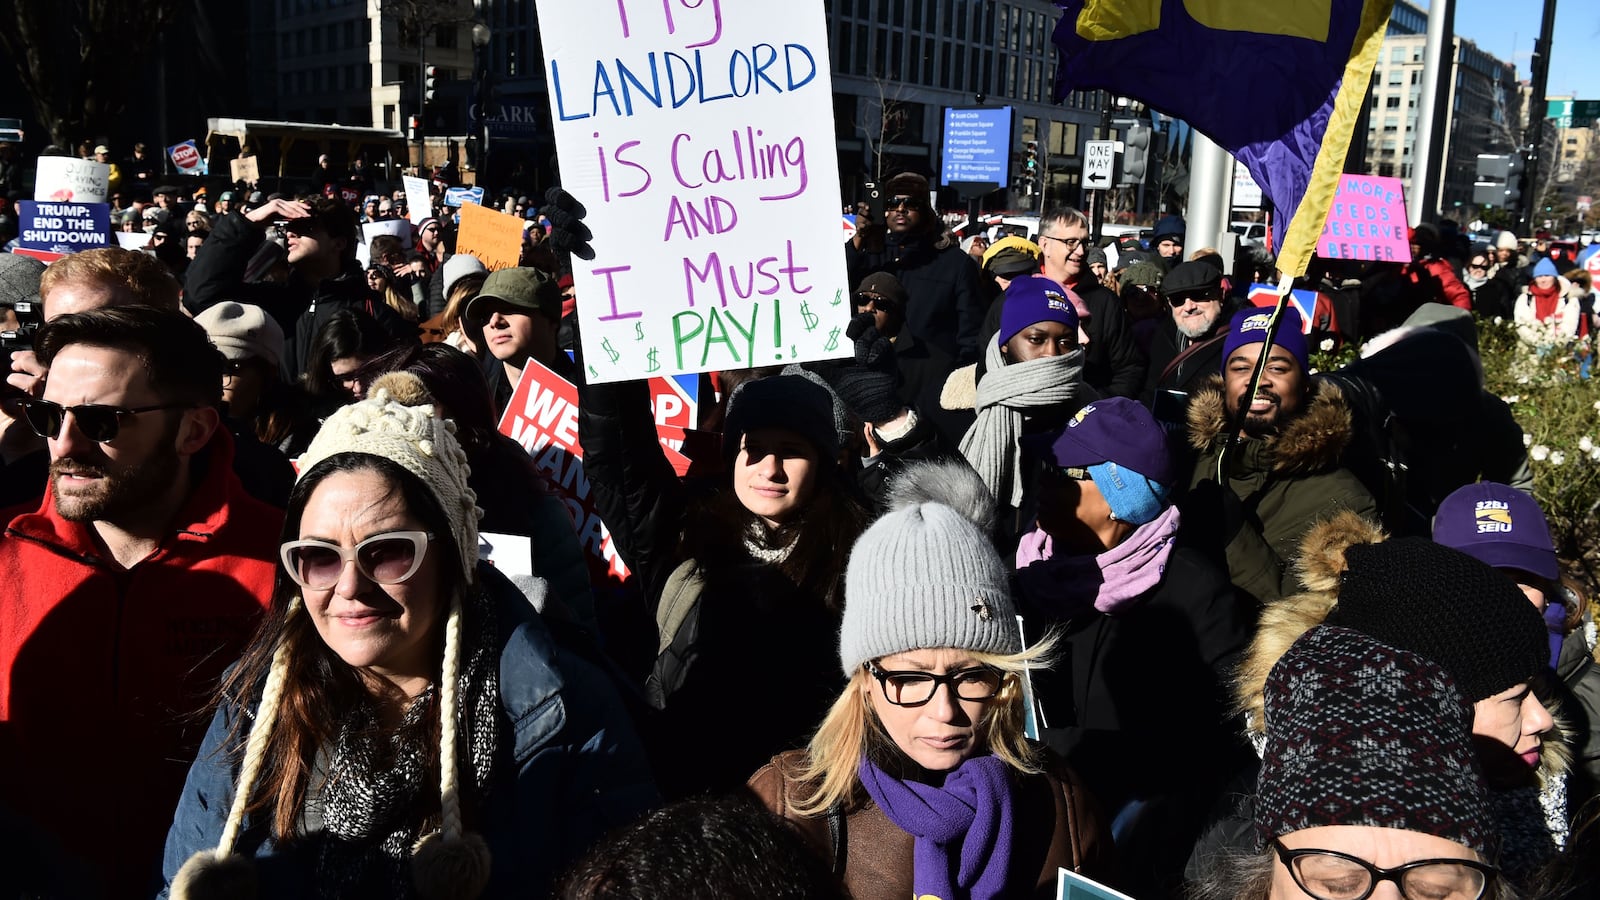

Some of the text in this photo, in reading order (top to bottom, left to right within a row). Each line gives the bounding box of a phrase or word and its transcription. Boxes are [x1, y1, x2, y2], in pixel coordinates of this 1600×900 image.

[551, 43, 817, 122] LANDLORD
[173, 147, 194, 160] STOP
[1090, 146, 1110, 156] ONE
[593, 126, 808, 203] is Calling
[1088, 159, 1109, 169] WAY
[36, 204, 90, 217] TRUMP:
[664, 195, 738, 241] AND
[1336, 203, 1389, 221] FEDS
[33, 217, 94, 231] END THE
[23, 230, 106, 244] SHUTDOWN
[1328, 241, 1394, 261] BETTER
[591, 239, 813, 321] I Must
[672, 299, 783, 370] PAY!
[523, 379, 580, 446] WE
[510, 415, 592, 501] WAN
[1475, 500, 1509, 511] 32BJ
[1477, 522, 1512, 533] SEIU
